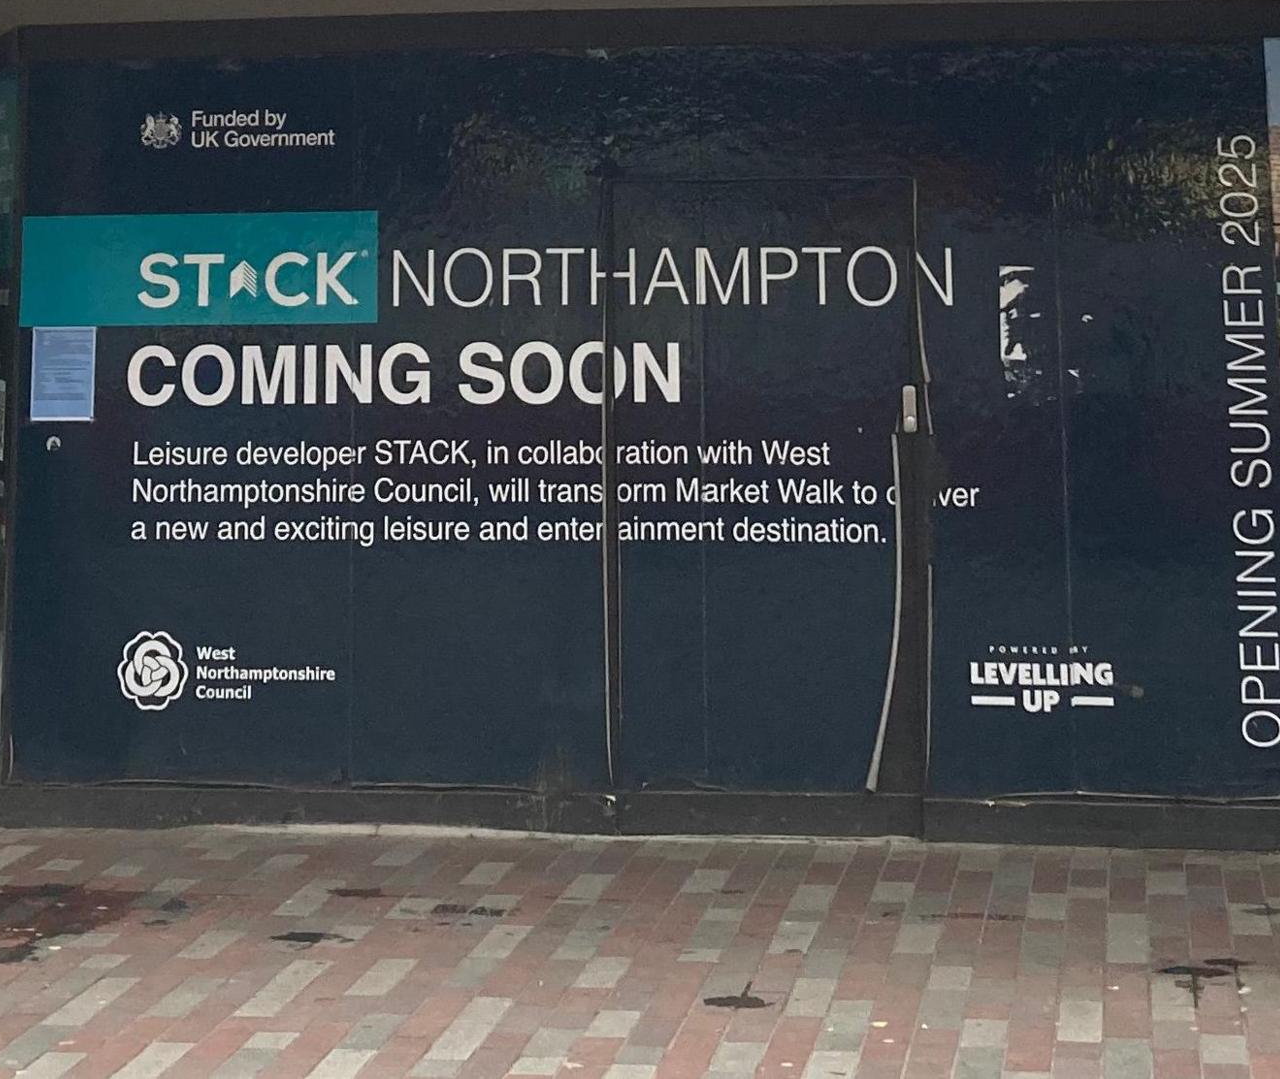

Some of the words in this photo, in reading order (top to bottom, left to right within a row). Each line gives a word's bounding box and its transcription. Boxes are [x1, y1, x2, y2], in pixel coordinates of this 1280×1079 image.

[192, 110, 259, 127] Funded
[264, 109, 287, 129] by
[192, 130, 219, 148] UK
[224, 129, 336, 148] Government
[1217, 134, 1261, 247] 2025
[392, 246, 954, 308] NORTHAMPTON
[127, 343, 431, 407] COMING
[458, 340, 681, 406] SOON
[1222, 265, 1272, 488] SUMMER
[133, 441, 228, 465] Leisure
[237, 441, 366, 471] developer
[375, 439, 477, 468] STACK,
[487, 440, 509, 464] in
[697, 440, 752, 465] with
[761, 440, 831, 466] West
[132, 478, 365, 508] Northamptonshire
[374, 478, 480, 506] Council,
[488, 478, 530, 504] will
[538, 478, 667, 504] transorm
[676, 478, 770, 505] Market
[776, 479, 844, 504] Walk
[852, 480, 877, 505] to
[131, 521, 146, 541] a
[156, 521, 208, 541] new
[217, 516, 265, 541] and
[275, 517, 374, 546] exciting
[384, 516, 470, 541] leisure
[480, 517, 527, 541] and
[537, 517, 725, 542] enterainment
[733, 517, 887, 543] destination.
[196, 646, 236, 660] West
[989, 646, 1058, 654] POWERED
[196, 666, 336, 684] Northamptonshire
[970, 662, 1115, 686] LEVELLING
[196, 684, 252, 699] Council
[1022, 689, 1061, 712] UP
